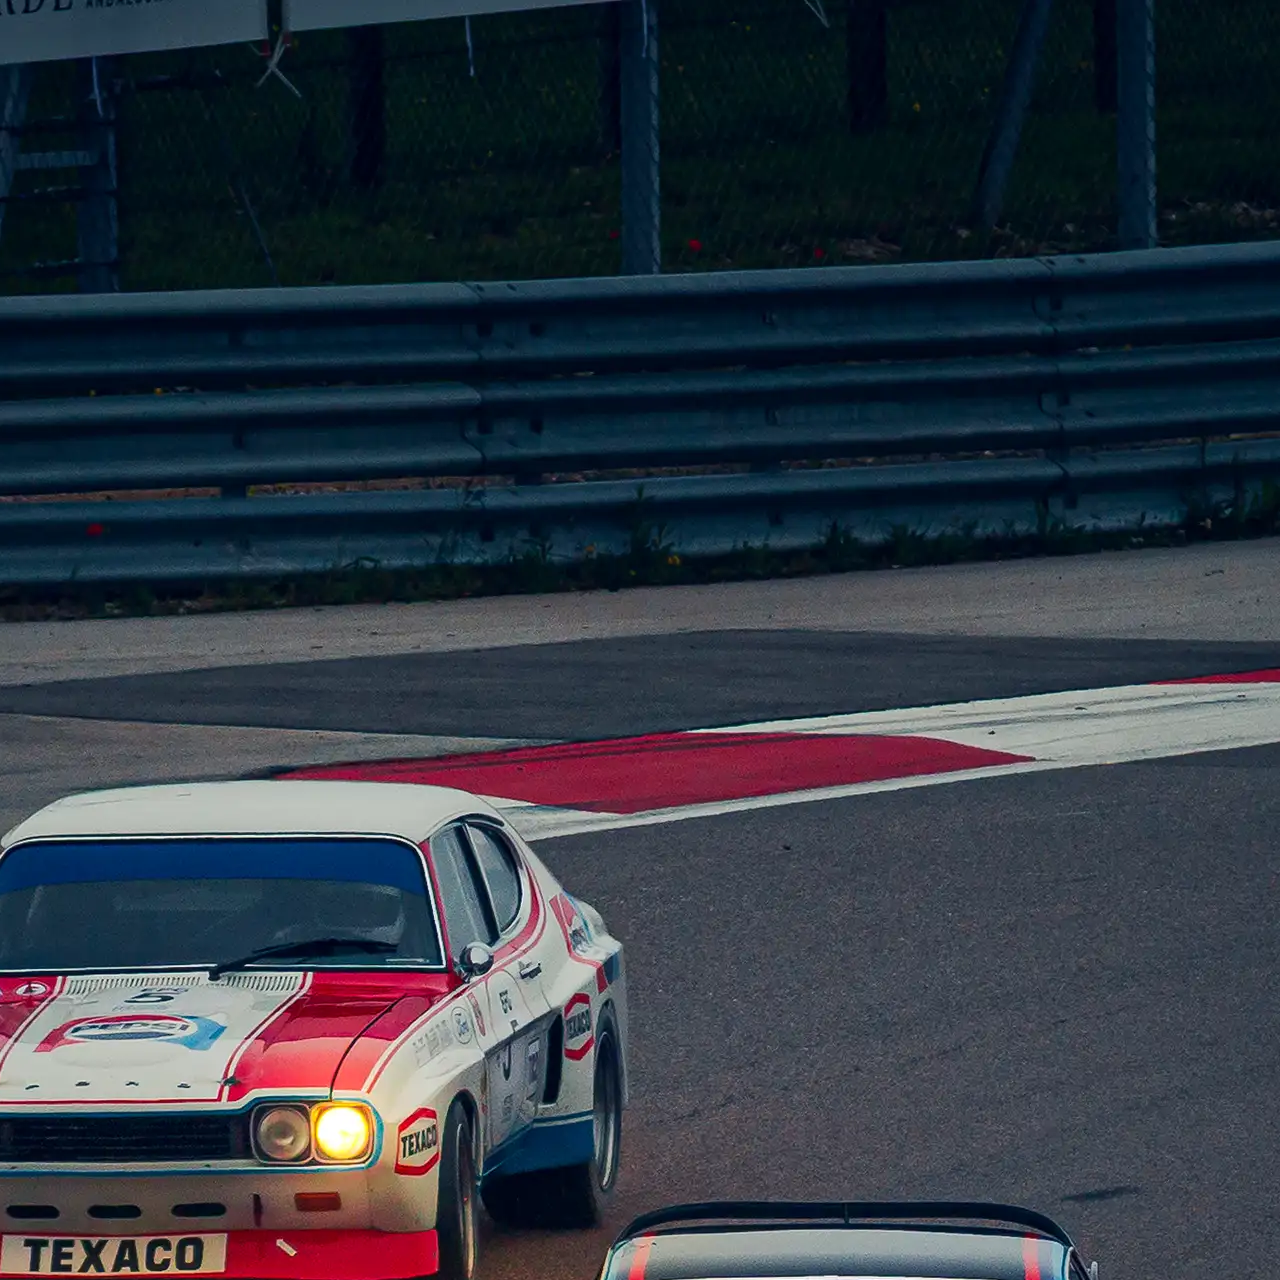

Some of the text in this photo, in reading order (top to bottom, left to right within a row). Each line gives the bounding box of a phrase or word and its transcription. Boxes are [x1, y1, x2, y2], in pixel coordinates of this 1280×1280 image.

[124, 992, 180, 1004] 5
[70, 1022, 189, 1034] PEPSI
[401, 1124, 437, 1158] TEXACO
[23, 1236, 205, 1273] TEXACO
